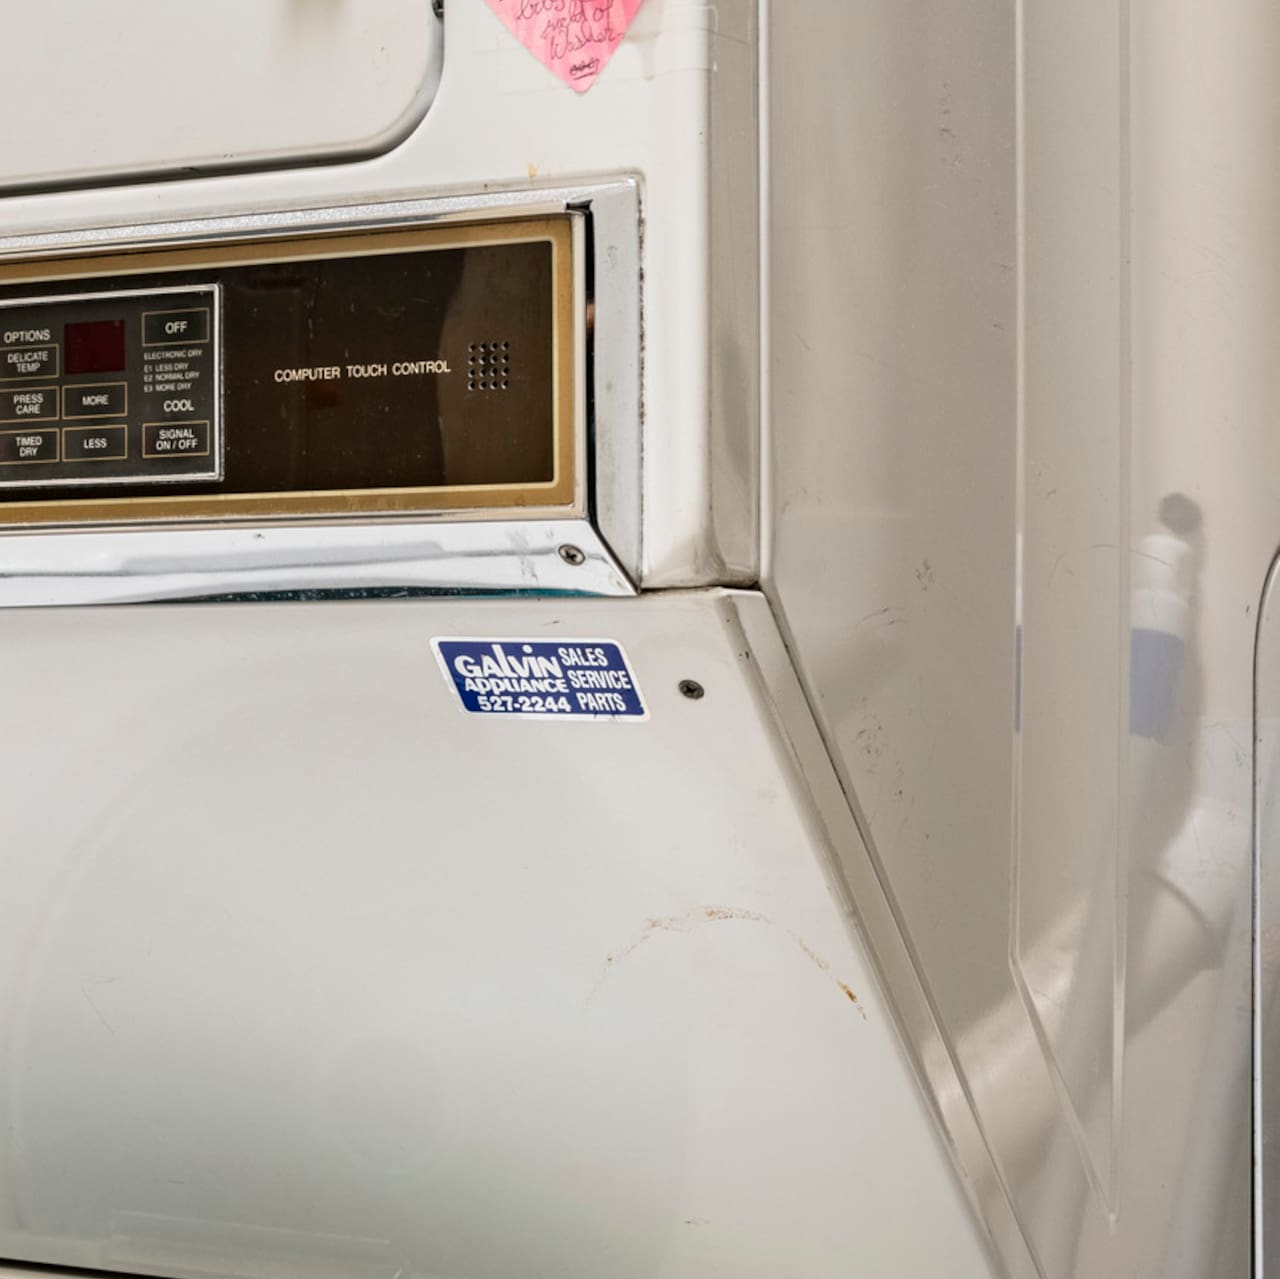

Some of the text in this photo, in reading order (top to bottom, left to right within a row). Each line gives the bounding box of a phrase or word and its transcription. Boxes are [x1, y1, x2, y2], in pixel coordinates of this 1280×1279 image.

[165, 321, 188, 334] OFF
[4, 329, 51, 343] OPTIONS
[7, 351, 49, 363] DELICATE
[143, 348, 202, 360] ELECTRONIC DRY
[17, 362, 41, 373] TEMP
[155, 363, 173, 372] LESS
[175, 362, 189, 370] DRY
[274, 360, 452, 383] COMPUTER TOUCH CONTROL
[155, 372, 184, 381] NORMAL
[184, 370, 200, 379] DRY
[155, 383, 175, 392] MORE
[176, 382, 192, 391] DRY
[13, 394, 44, 405] PRESS
[82, 394, 109, 405] MORE
[15, 404, 41, 414] CARE
[163, 400, 195, 413] COOL
[159, 428, 195, 439] SIGNAL
[15, 436, 43, 447] TIMED
[83, 438, 108, 449] LESS
[156, 440, 170, 451] ON
[178, 438, 198, 449] OFF
[19, 446, 39, 457] DRY
[558, 647, 608, 667] SALES
[567, 669, 631, 689] SERVICE
[477, 696, 571, 712] 527-2244
[576, 692, 627, 712] PARTS
